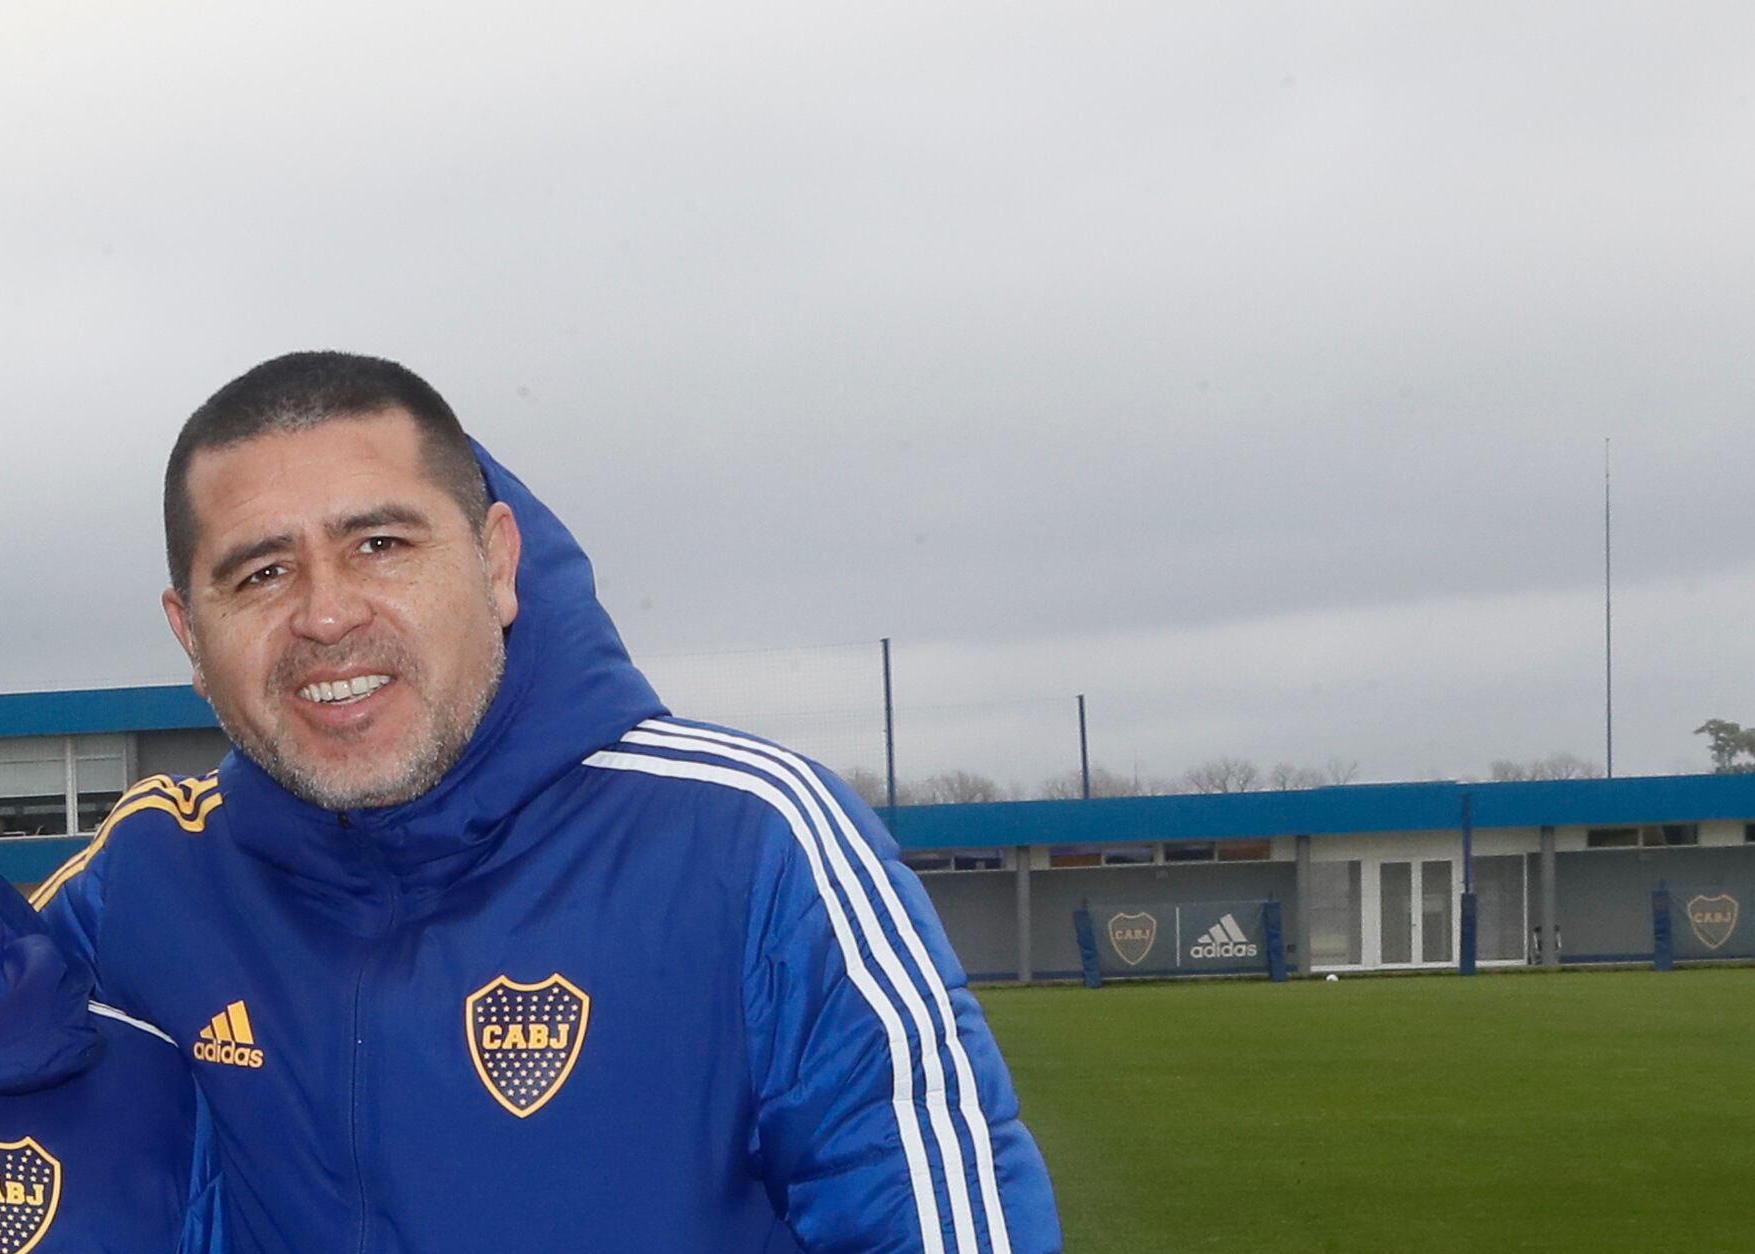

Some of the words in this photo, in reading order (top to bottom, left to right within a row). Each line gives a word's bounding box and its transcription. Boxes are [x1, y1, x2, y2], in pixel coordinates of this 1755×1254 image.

[1114, 927, 1150, 941] CABJ
[1190, 941, 1258, 959] adidas
[482, 1023, 570, 1051] CABJ
[193, 1039, 264, 1069] adidas
